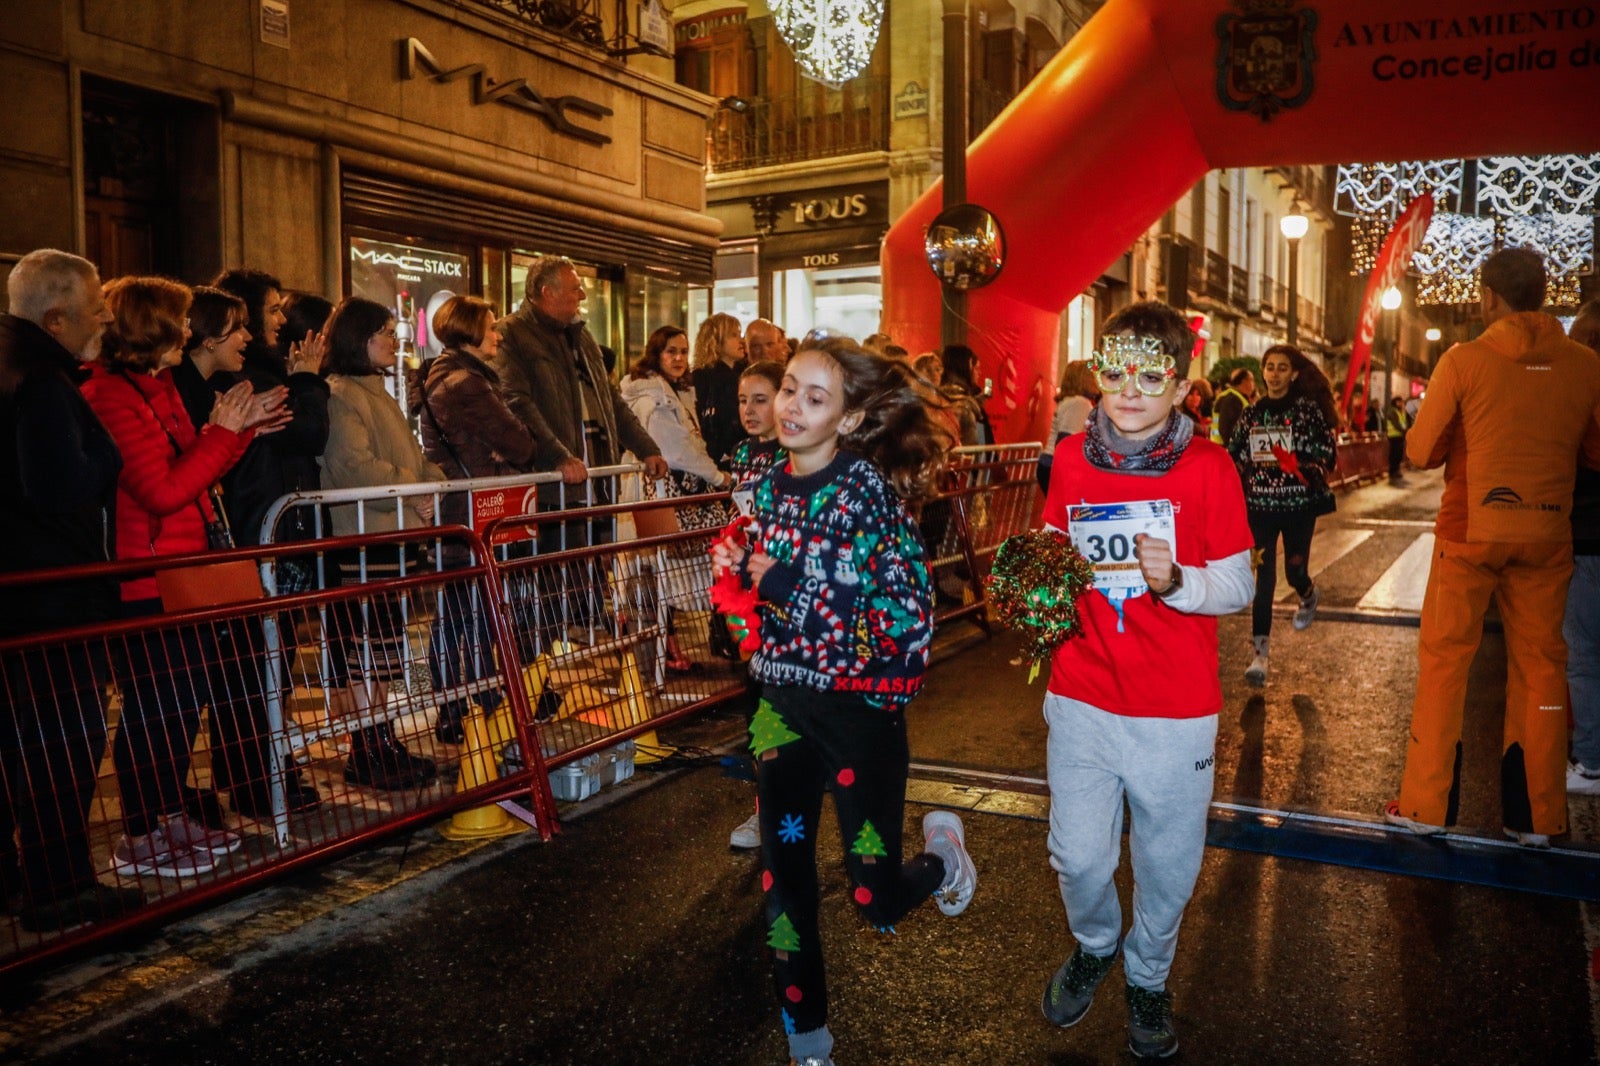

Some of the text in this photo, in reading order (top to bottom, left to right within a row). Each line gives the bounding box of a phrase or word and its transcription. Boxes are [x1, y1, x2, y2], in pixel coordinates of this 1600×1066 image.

[1333, 6, 1595, 48] AYUNTAMIENTO
[1372, 40, 1557, 82] Concejalía
[790, 193, 868, 223] TOUS
[424, 259, 462, 277] STACK
[803, 252, 839, 267] TOUS
[476, 491, 505, 509] CALERO
[477, 506, 505, 518] AGUILERA
[762, 659, 832, 691] OUTFIT
[833, 677, 905, 694] XMAS
